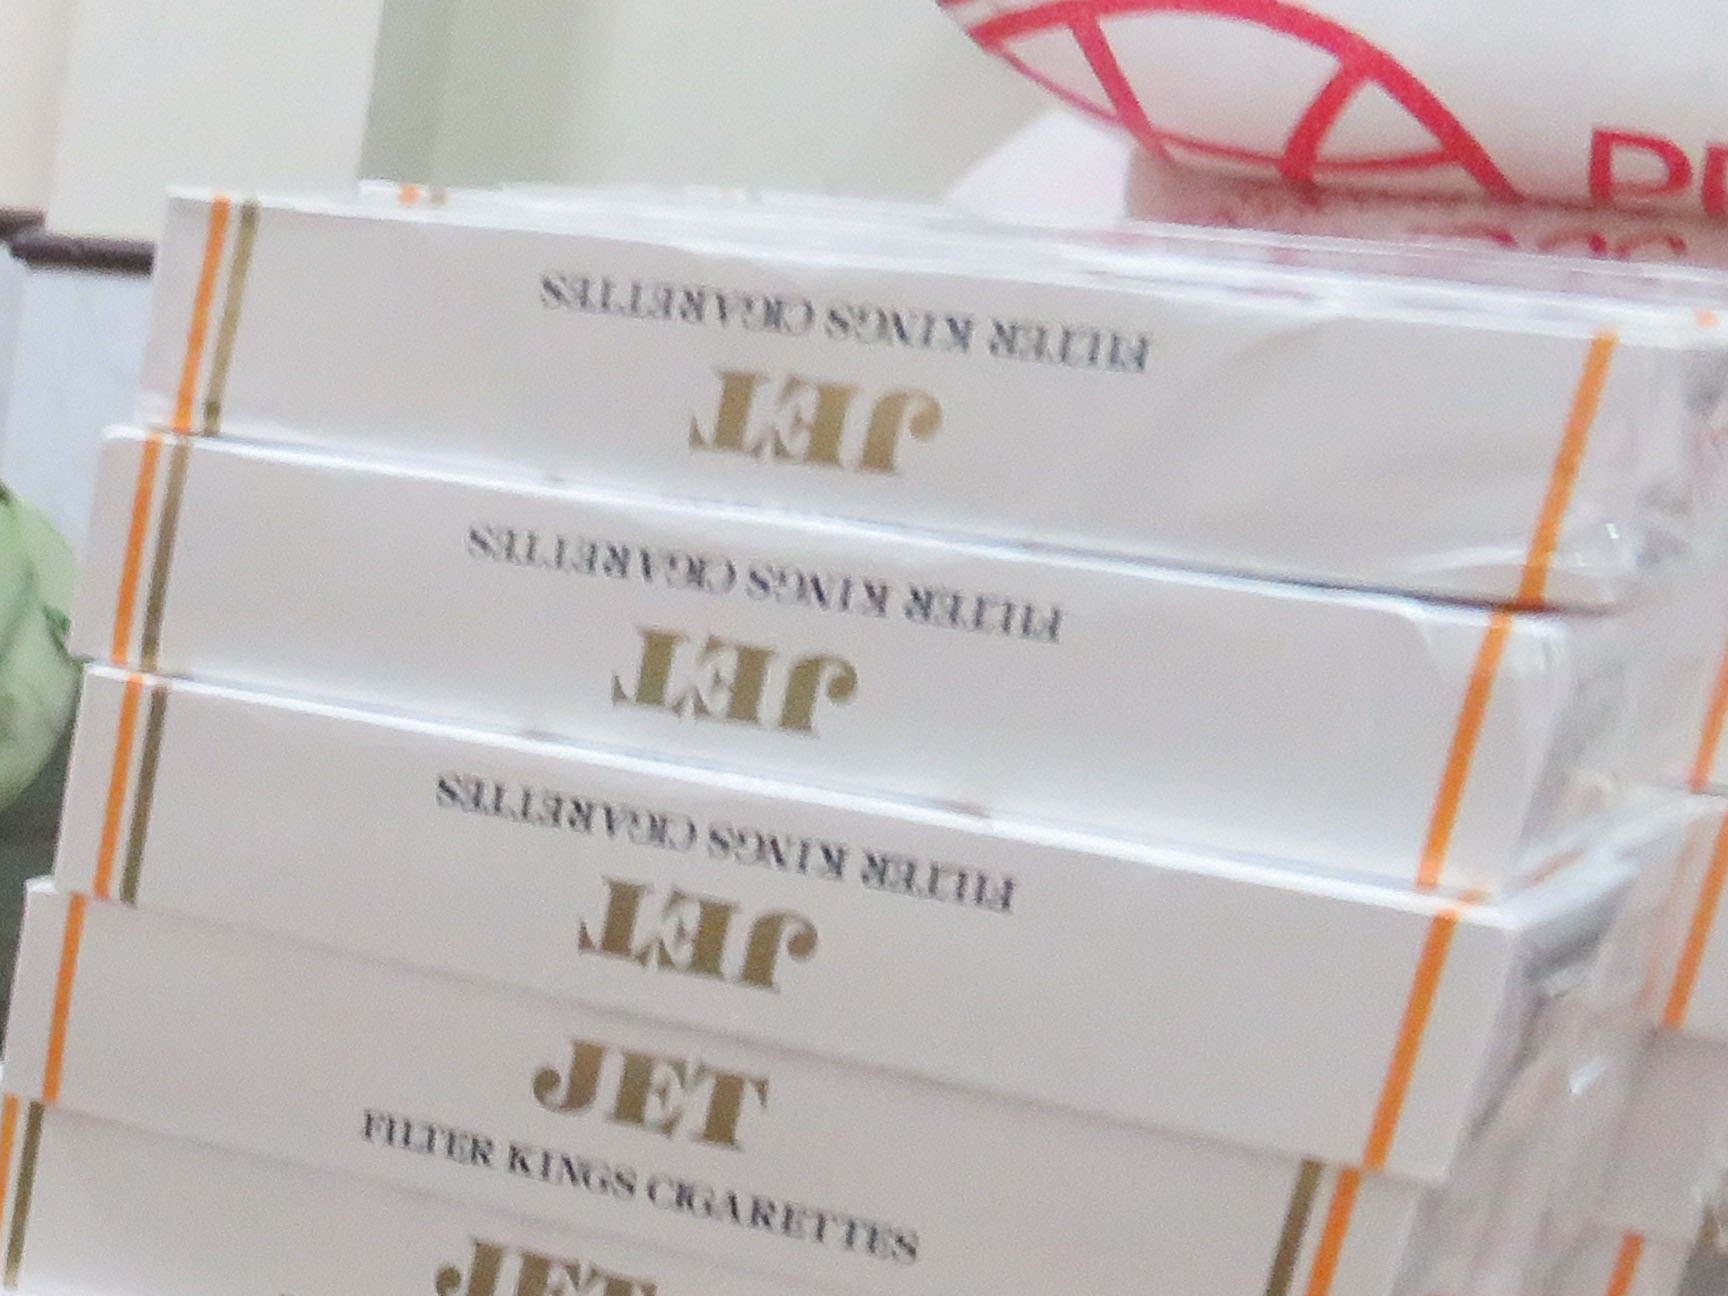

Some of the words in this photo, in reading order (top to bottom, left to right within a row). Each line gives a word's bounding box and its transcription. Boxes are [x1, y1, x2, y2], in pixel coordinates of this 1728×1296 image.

[539, 273, 818, 335] CIGARETTES
[825, 303, 976, 355] KINGS
[987, 318, 1152, 375] FILTER
[689, 367, 943, 475] JET
[467, 525, 739, 594] CIGARETTES
[745, 564, 892, 620] KINGS
[902, 583, 1064, 645] FILTER
[611, 627, 859, 736] JET
[435, 772, 700, 852] CIGARETTES
[706, 824, 851, 884] KINGS
[858, 849, 1019, 915] FILTER
[578, 878, 819, 993] JET
[531, 1035, 769, 1150] JET
[361, 1108, 497, 1170] FILTER
[506, 1140, 639, 1200] KINGS
[644, 1175, 921, 1265] CIGARETTES
